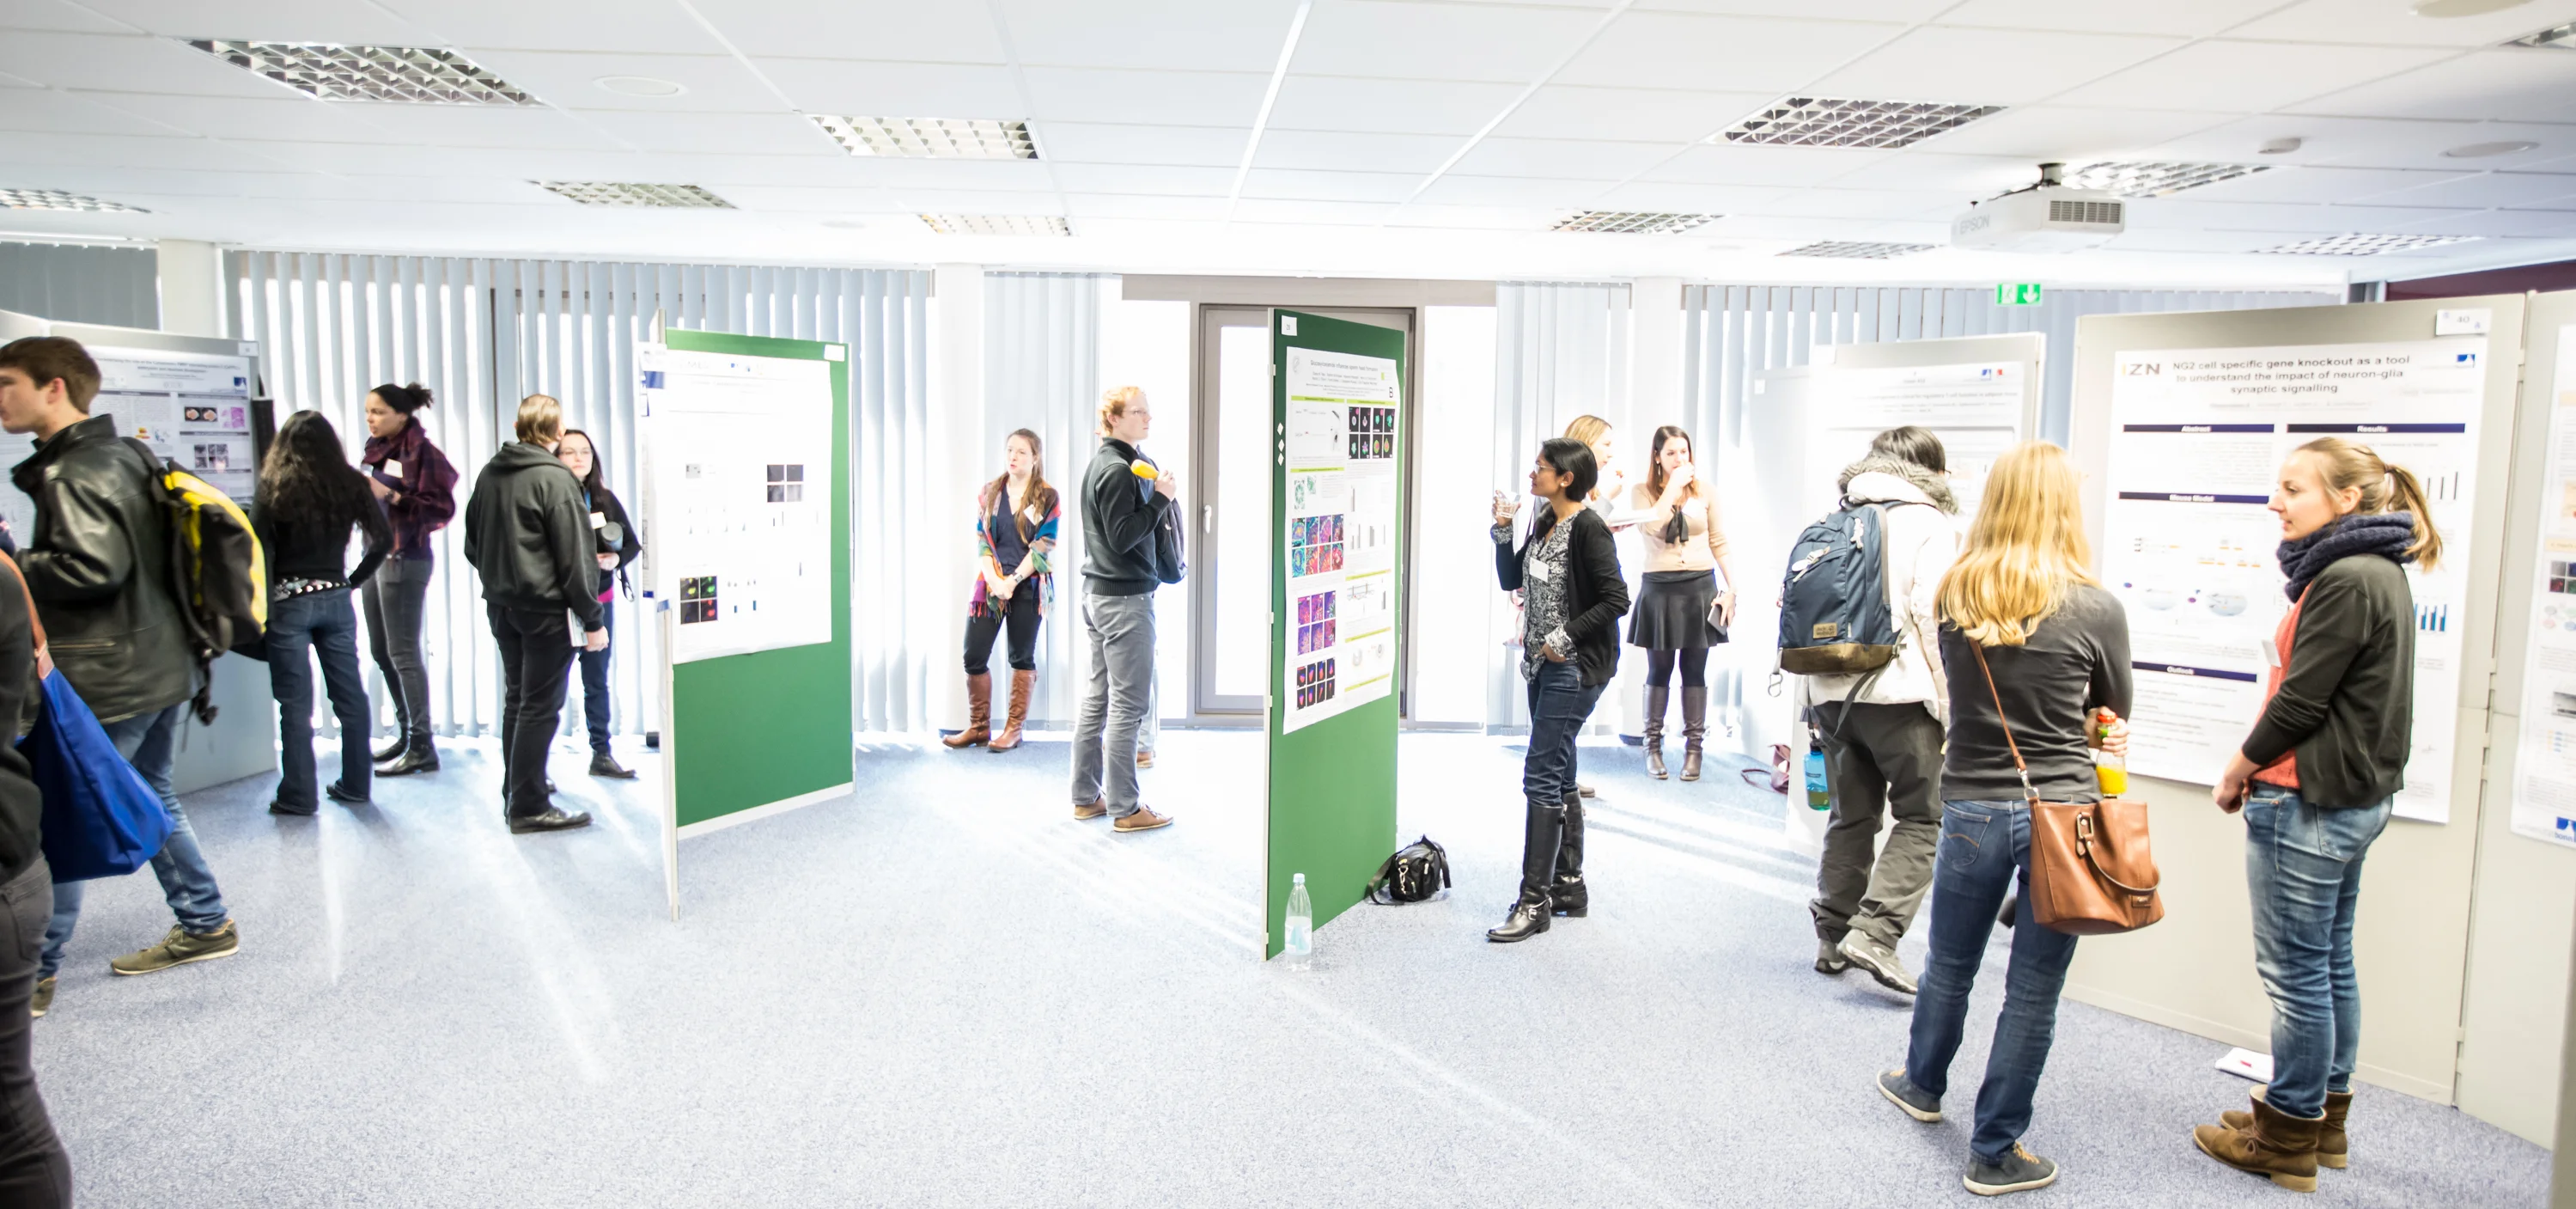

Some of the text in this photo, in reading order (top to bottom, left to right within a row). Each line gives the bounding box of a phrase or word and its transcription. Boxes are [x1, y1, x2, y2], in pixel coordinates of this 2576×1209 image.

[1959, 214, 1990, 235] EPSON
[2172, 362, 2195, 370] NG2
[2198, 361, 2217, 369] cell
[2220, 360, 2262, 369] specific
[2266, 361, 2294, 369] gene
[2297, 357, 2353, 367] knockout
[2385, 355, 2410, 365] tool
[2189, 373, 2251, 382] understand
[2254, 373, 2272, 382] the
[2275, 371, 2315, 382] impact
[2317, 370, 2330, 380] of
[2333, 369, 2403, 380] neuron-glia
[2230, 384, 2339, 395] synaptic signalling
[2166, 666, 2194, 675] Outlook
